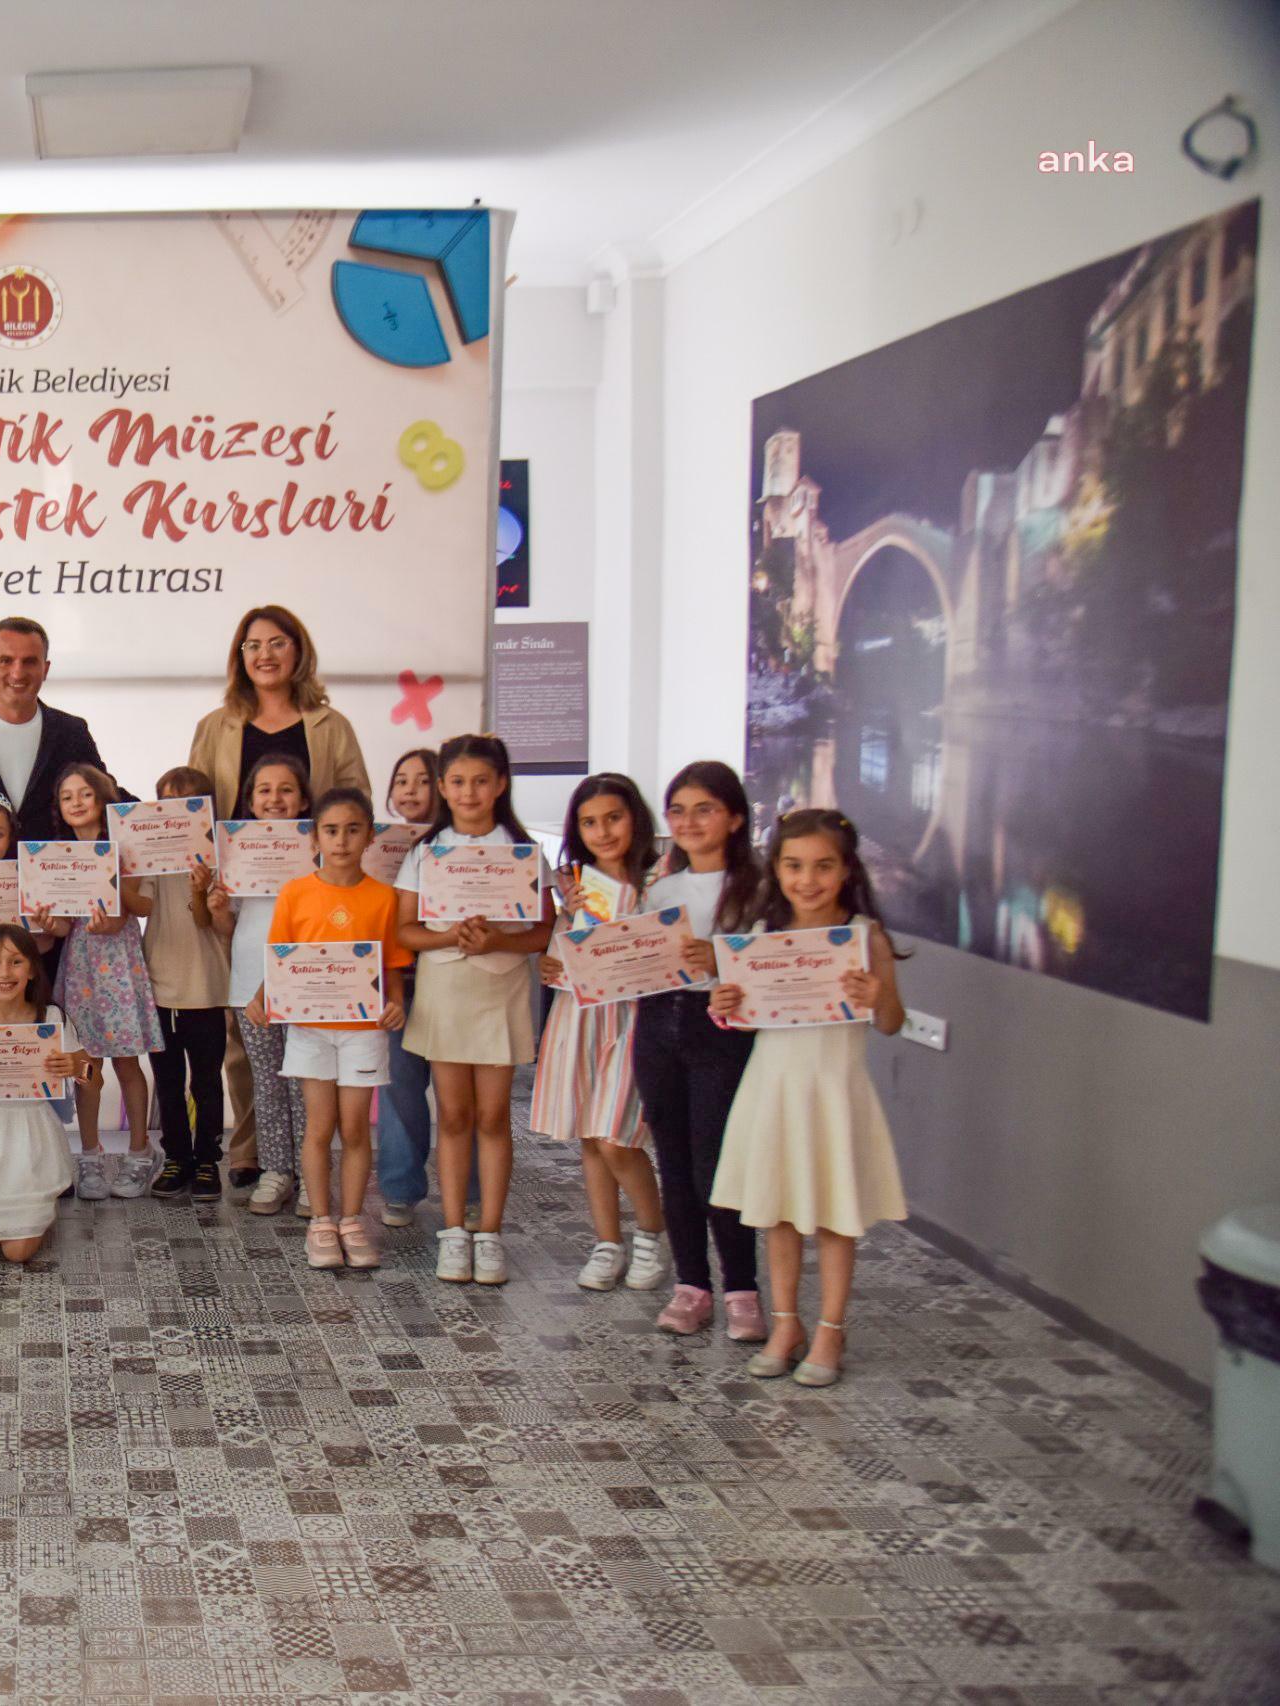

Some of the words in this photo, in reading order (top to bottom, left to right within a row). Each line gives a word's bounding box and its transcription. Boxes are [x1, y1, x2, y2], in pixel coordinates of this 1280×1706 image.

[31, 366, 171, 399] Belediyesi
[88, 408, 339, 467] Müzesi
[53, 560, 224, 595] Hatırası
